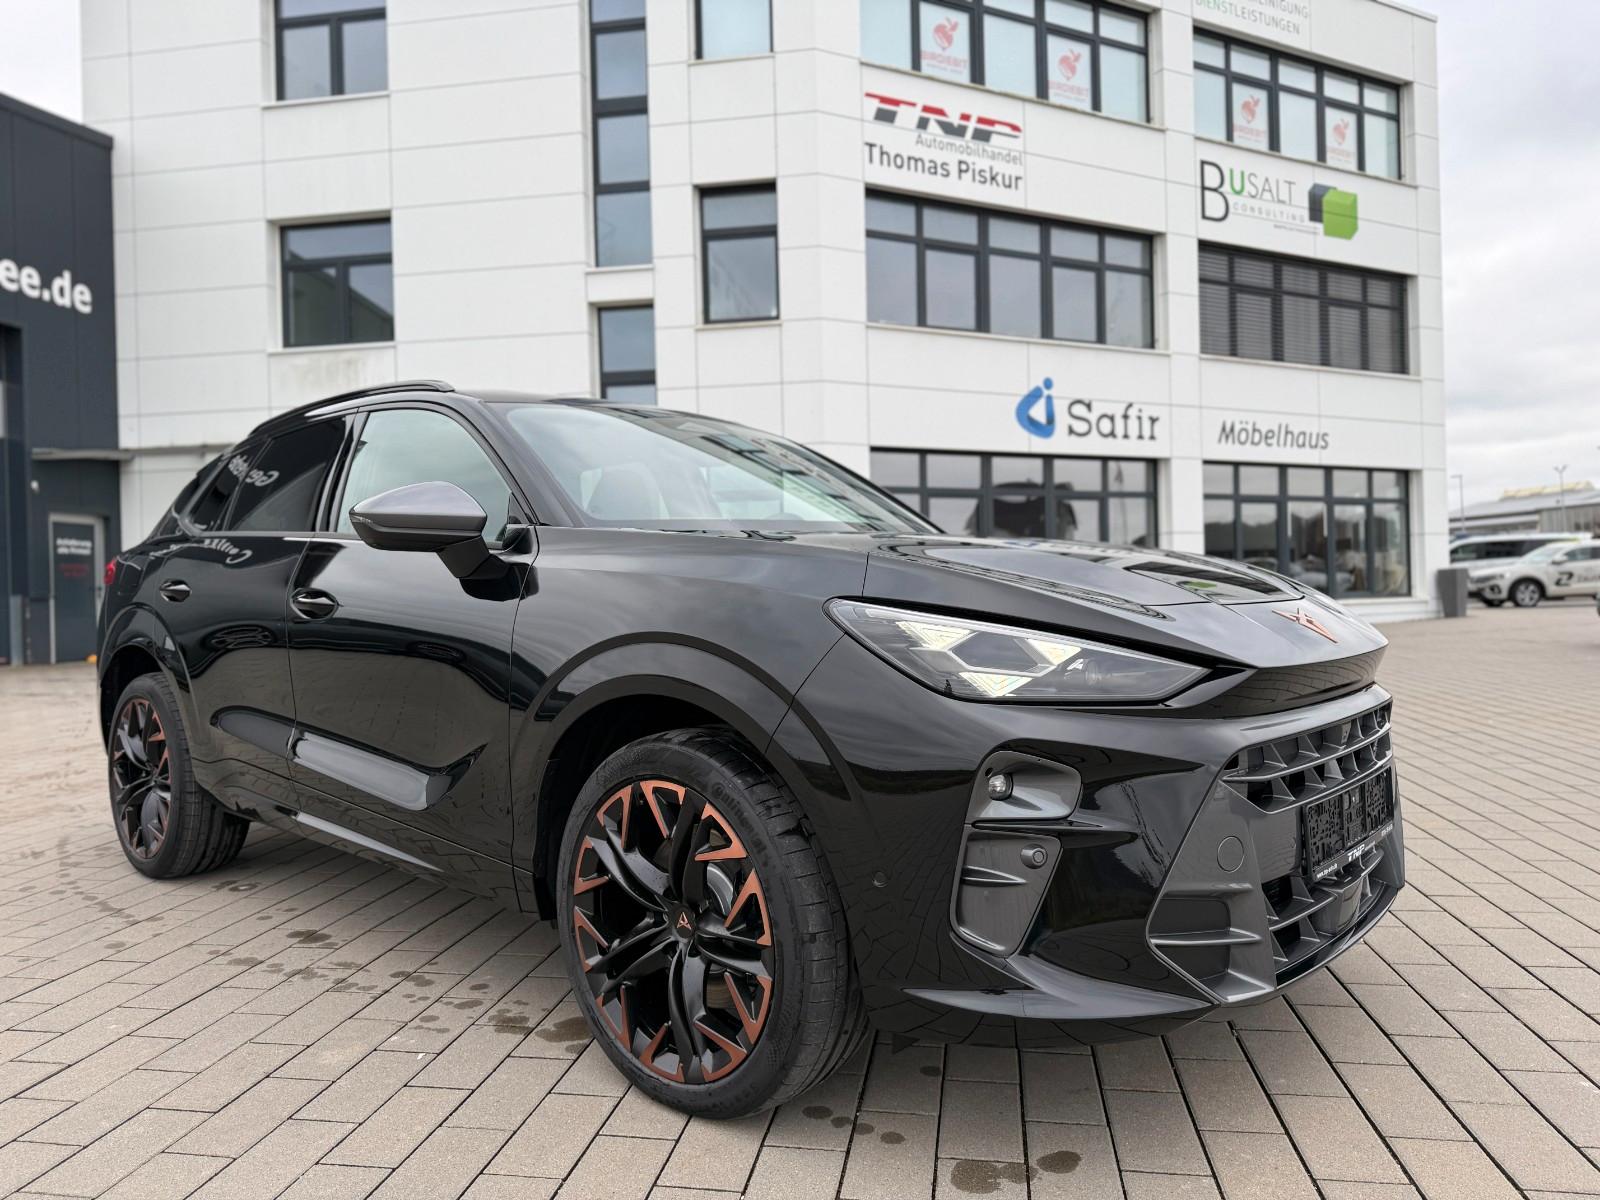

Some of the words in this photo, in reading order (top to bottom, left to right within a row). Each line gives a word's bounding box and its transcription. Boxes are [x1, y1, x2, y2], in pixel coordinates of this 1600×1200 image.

[864, 92, 1023, 143] TNP
[865, 142, 951, 179] Thomas
[957, 160, 1023, 191] Piskur
[915, 133, 1023, 167] Automobilhandel
[1068, 399, 1160, 441] Safir
[1218, 420, 1329, 450] Möbelhaus
